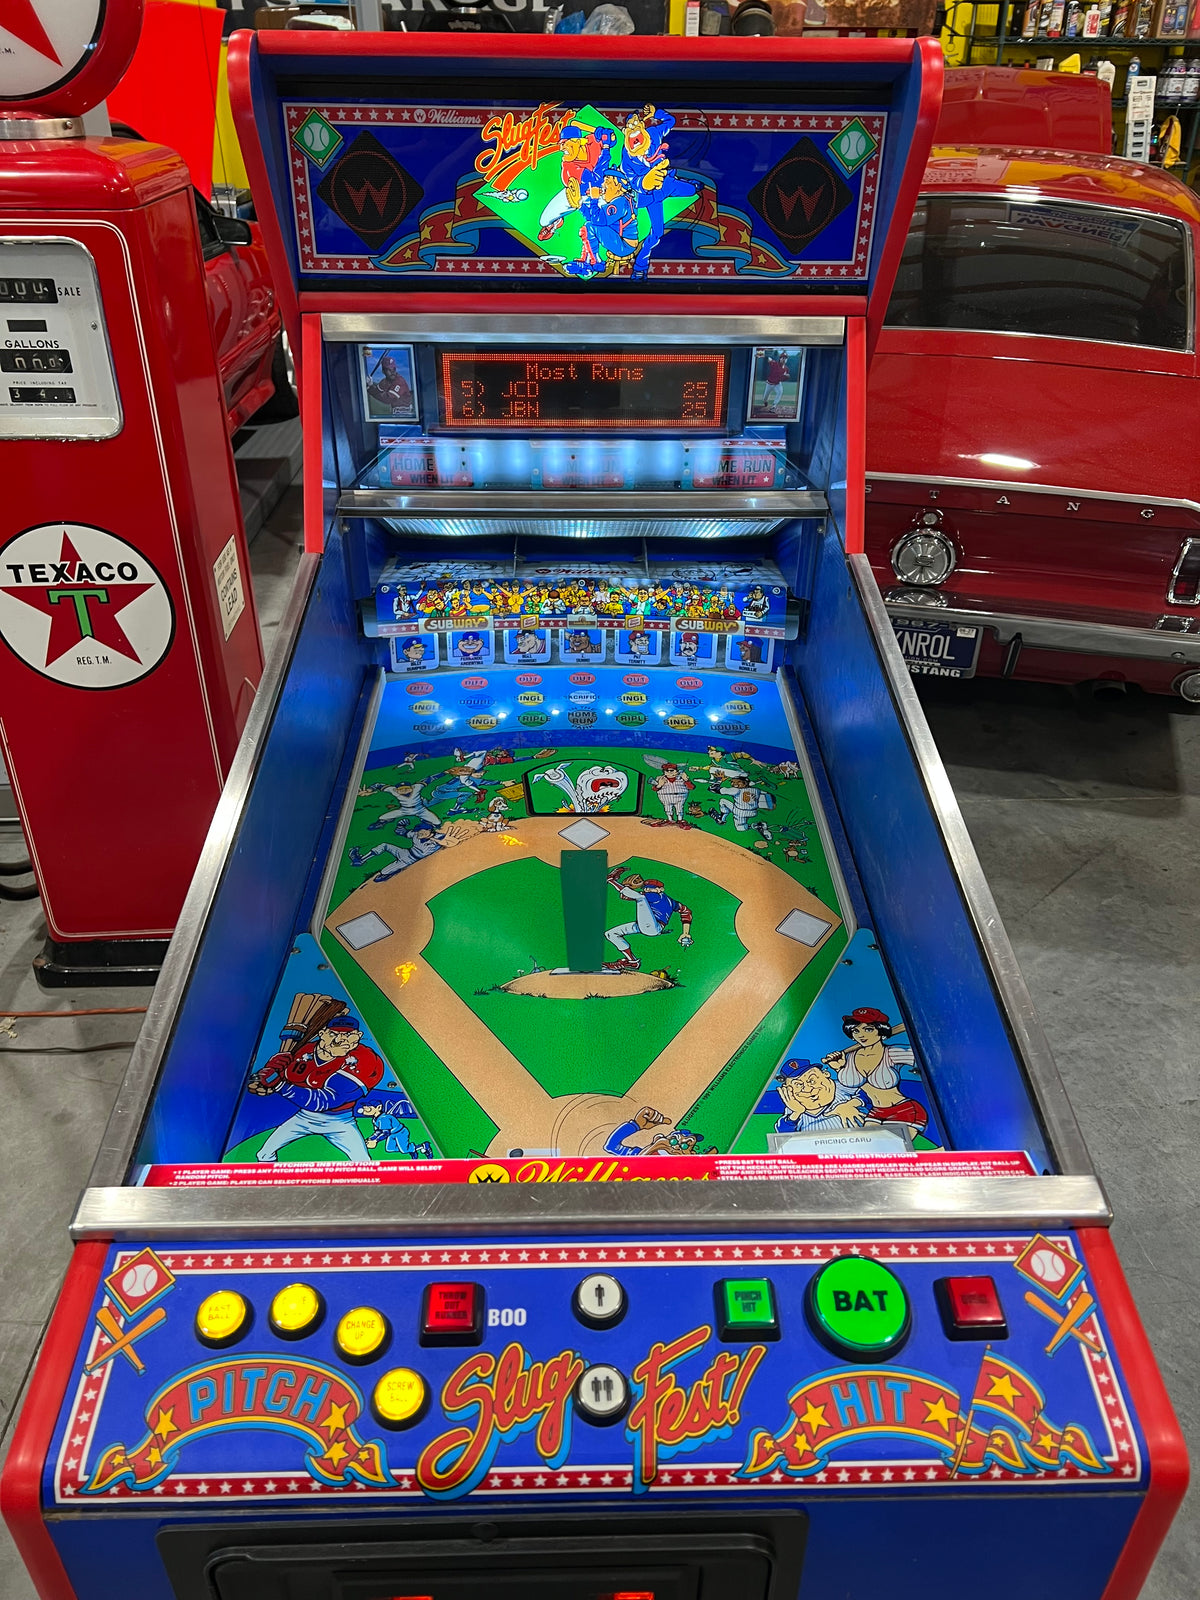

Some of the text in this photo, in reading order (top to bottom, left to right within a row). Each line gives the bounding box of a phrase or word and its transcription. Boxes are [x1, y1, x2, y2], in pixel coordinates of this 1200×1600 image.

[427, 109, 482, 126] Williams
[57, 287, 82, 297] SALE
[4, 340, 60, 349] GALLONS
[526, 362, 645, 381] Most Runs
[461, 381, 709, 400] 5) JCD 25
[462, 401, 708, 419] 6) JBN 25
[393, 457, 434, 472] HOME
[742, 459, 773, 474] RUN
[410, 474, 439, 485] WHEN
[711, 475, 757, 486] WHEN LIT
[6, 562, 138, 583] TEXACO
[46, 588, 110, 639] T
[427, 618, 487, 630] SUBWAY
[678, 618, 738, 631] SUBWAY
[76, 655, 112, 665] REG. T.M.
[518, 676, 539, 684] OUT
[572, 675, 592, 683] OUT
[625, 676, 646, 684] OUT
[679, 679, 700, 687] OUT
[733, 685, 754, 693] OUT
[465, 718, 501, 726] SINGLE
[517, 715, 551, 723] TRIPLE
[615, 715, 649, 723] TRIPLE
[663, 718, 700, 726] SINGLE
[711, 723, 751, 732] DOUBLE
[292, 1062, 307, 1075] 19
[814, 1136, 873, 1147] PRICING CARD
[316, 1160, 381, 1168] INSTRUCTIONS
[438, 1291, 467, 1300] THROW
[832, 1290, 889, 1312] BAT
[444, 1301, 460, 1310] OUT
[742, 1302, 756, 1313] HIT
[487, 1308, 528, 1327] BOO
[345, 1319, 377, 1330] CHANGE
[354, 1331, 366, 1341] UP
[386, 1380, 416, 1391] SCREW
[187, 1367, 333, 1424] PITCH
[417, 1325, 767, 1493] Slug Fest!
[829, 1380, 912, 1428] HIT
